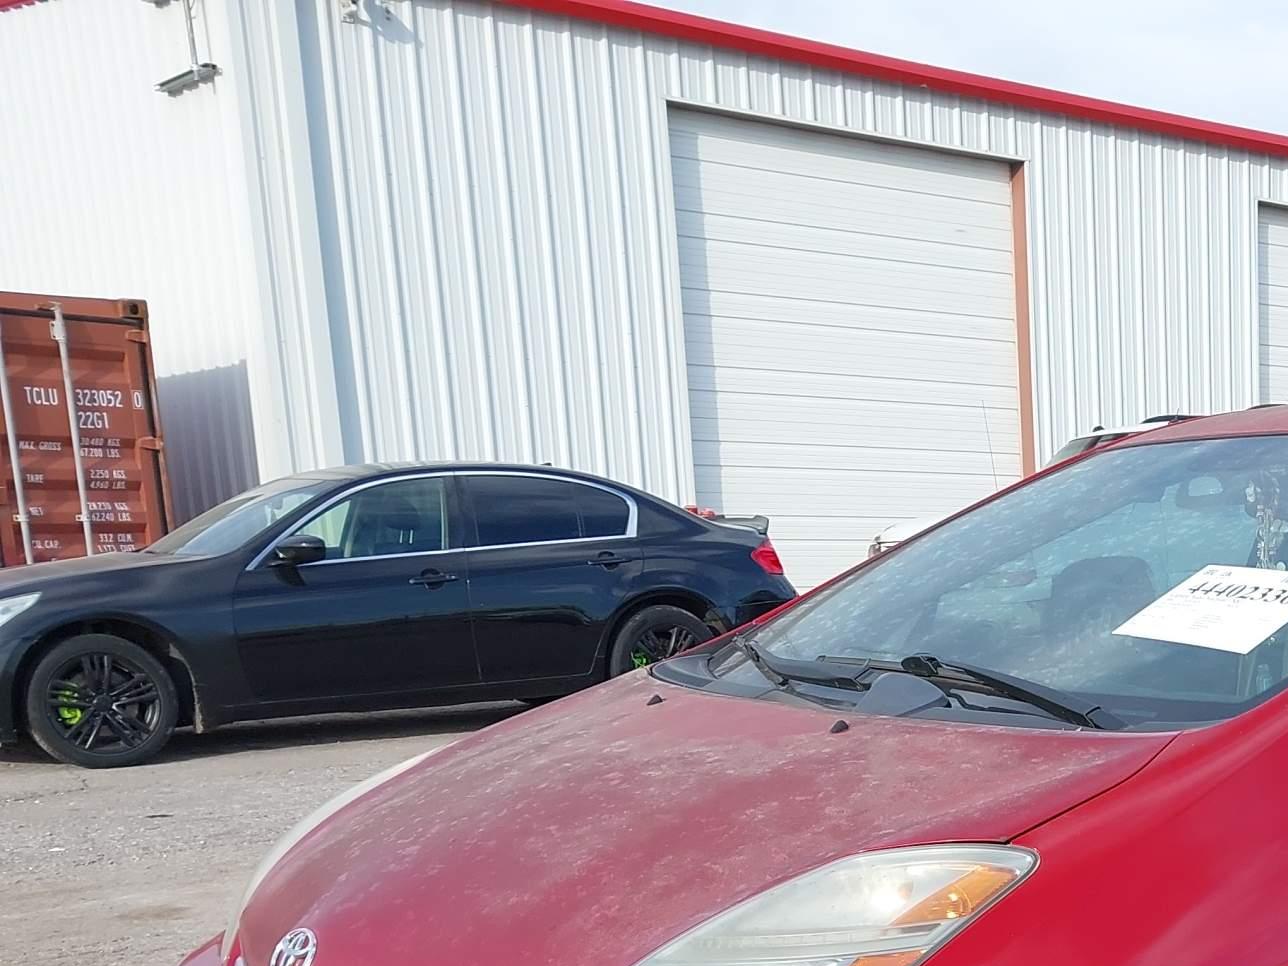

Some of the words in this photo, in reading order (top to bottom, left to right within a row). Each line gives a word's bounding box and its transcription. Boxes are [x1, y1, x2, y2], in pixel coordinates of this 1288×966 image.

[24, 386, 58, 405] TCLU
[75, 389, 123, 408] 323052
[78, 412, 109, 429] 22G1
